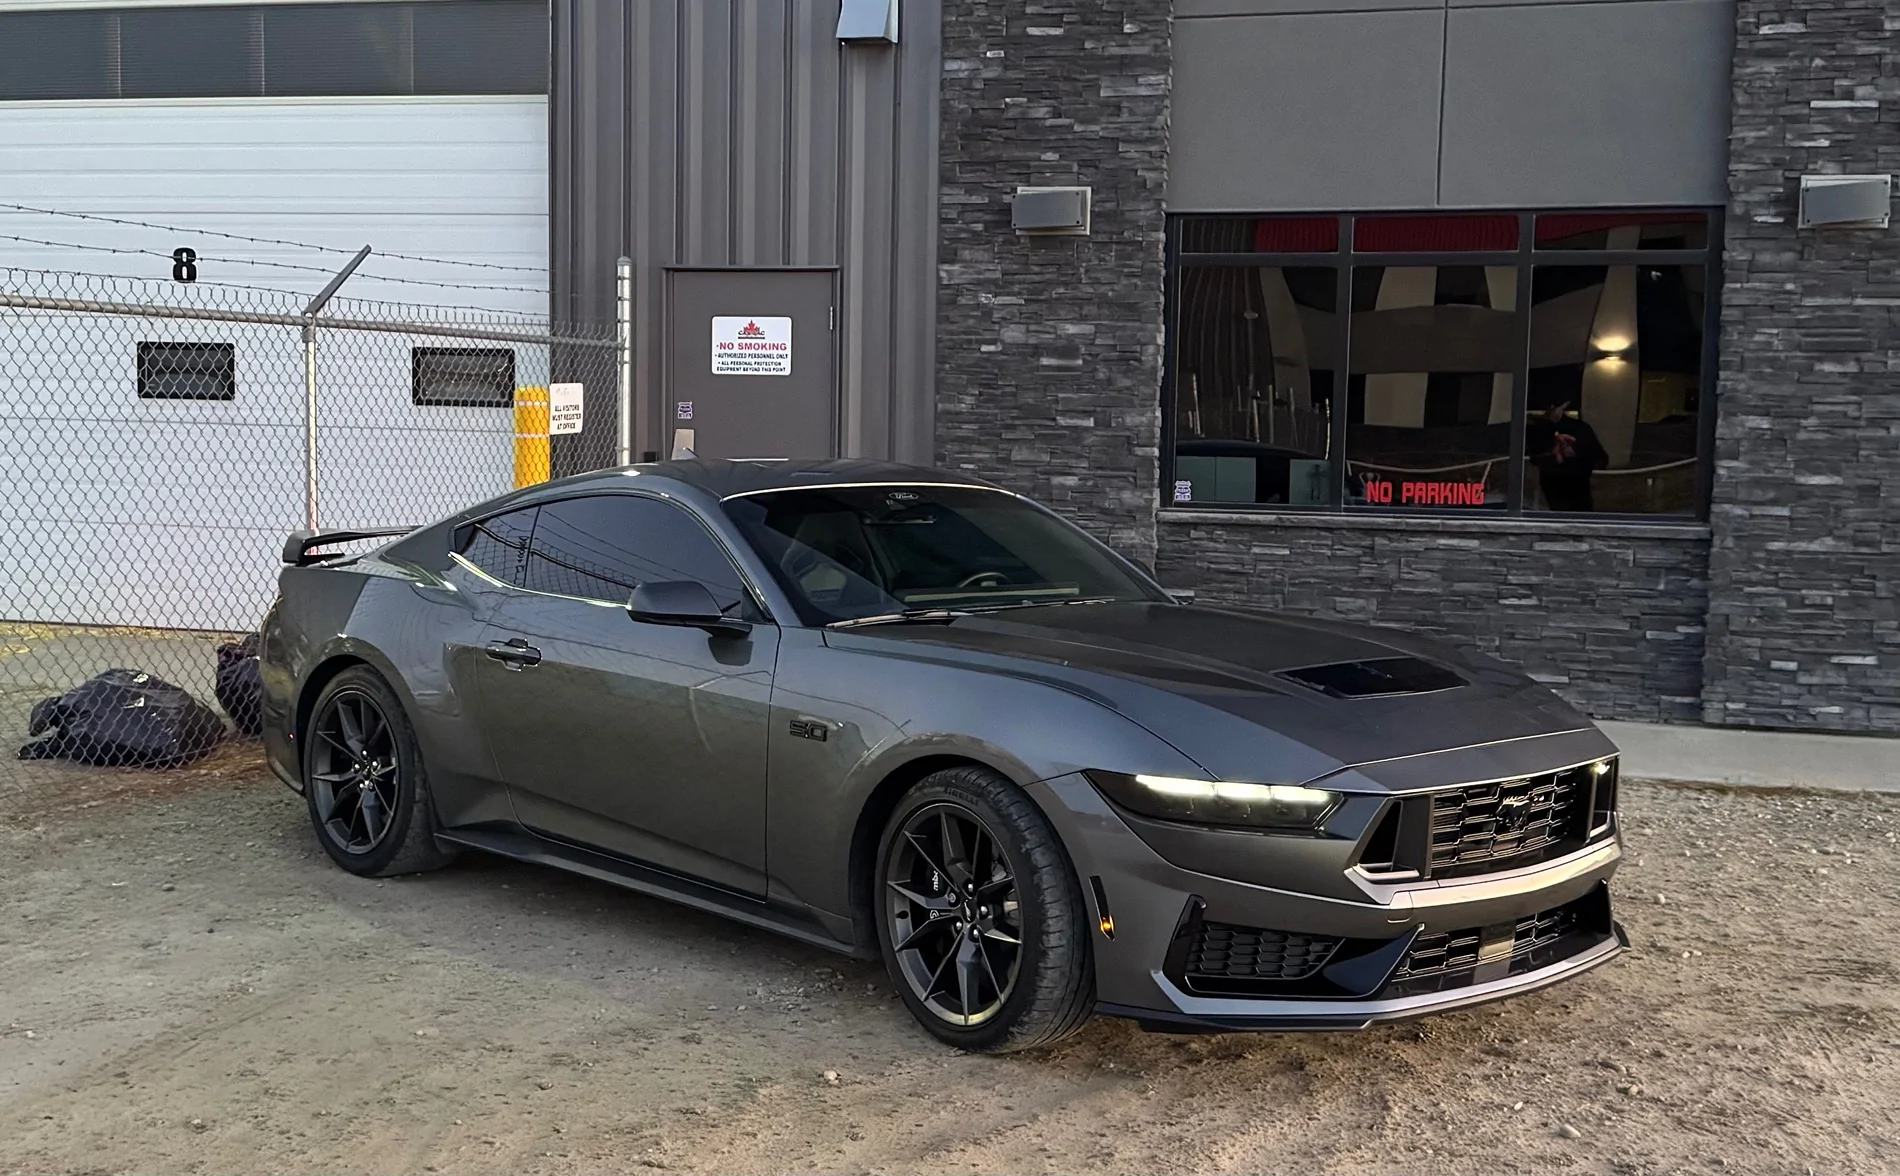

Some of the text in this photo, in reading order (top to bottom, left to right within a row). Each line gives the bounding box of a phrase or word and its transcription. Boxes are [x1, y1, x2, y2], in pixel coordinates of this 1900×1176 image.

[172, 247, 197, 284] 8
[719, 342, 787, 350] NO SMOKING
[563, 422, 576, 430] OFFICE
[1365, 481, 1485, 505] NO PARKING
[789, 720, 828, 742] 5.0
